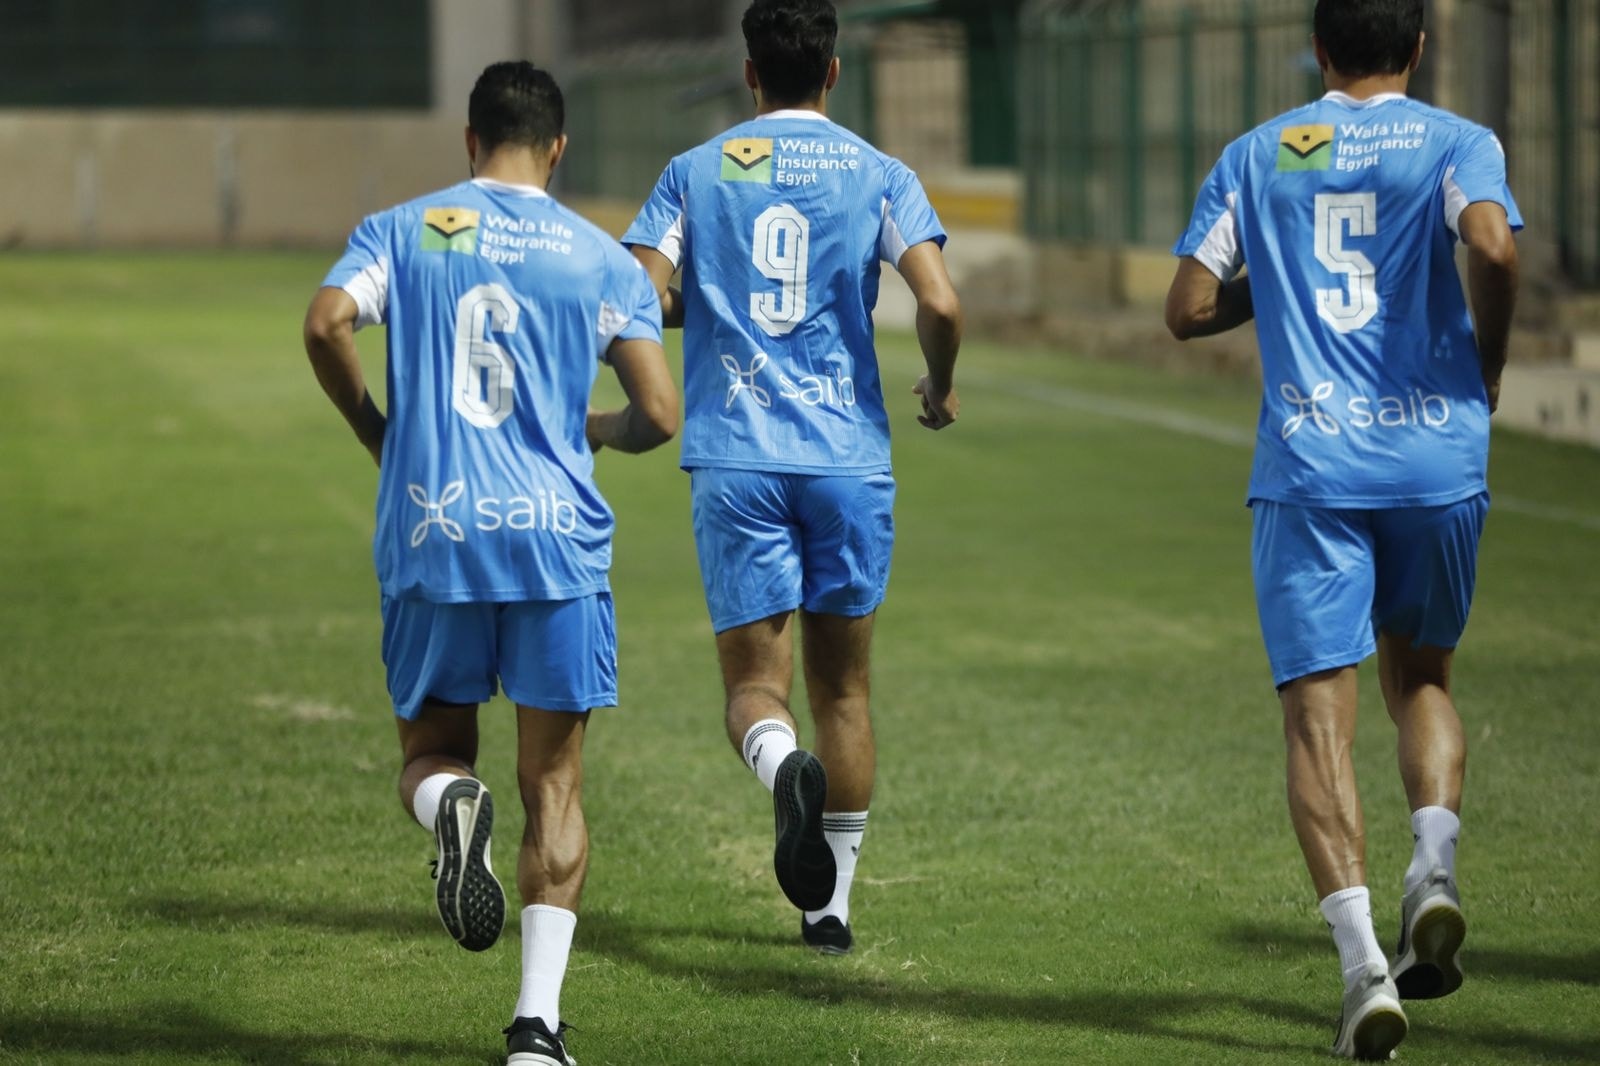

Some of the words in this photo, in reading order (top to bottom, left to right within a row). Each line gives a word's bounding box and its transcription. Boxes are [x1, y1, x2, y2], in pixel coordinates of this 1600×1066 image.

[1341, 123, 1388, 139] Wafa
[1393, 122, 1425, 134] Life
[779, 138, 825, 154] Wafa
[829, 142, 859, 155] Life
[1338, 139, 1423, 156] Insurance
[777, 155, 858, 170] Insurance
[1336, 153, 1379, 172] Egypt
[776, 171, 817, 186] Egypt
[486, 213, 536, 233] Wafa
[541, 220, 573, 239] Life
[480, 243, 525, 265] Egypt
[483, 228, 572, 255] Insurance
[750, 203, 809, 336] 9
[1314, 193, 1378, 334] 5
[452, 282, 520, 429] 6
[779, 368, 855, 406] saib
[1348, 388, 1450, 428] saib
[475, 489, 577, 534] saib
